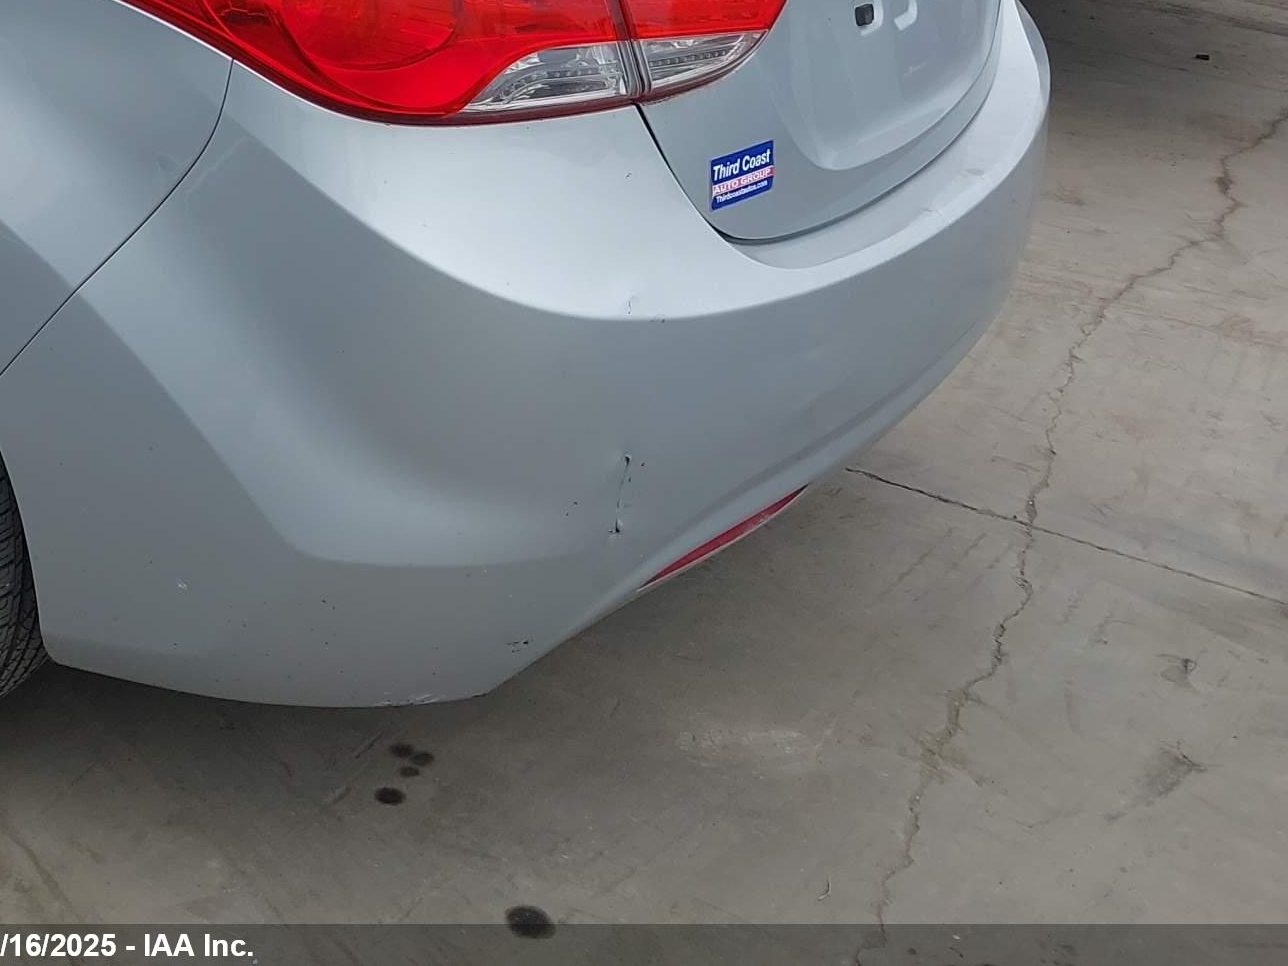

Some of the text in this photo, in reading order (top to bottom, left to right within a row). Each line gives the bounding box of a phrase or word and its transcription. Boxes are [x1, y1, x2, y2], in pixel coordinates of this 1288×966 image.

[713, 148, 771, 181] Third Coast
[713, 168, 771, 194] AUTO GROUP
